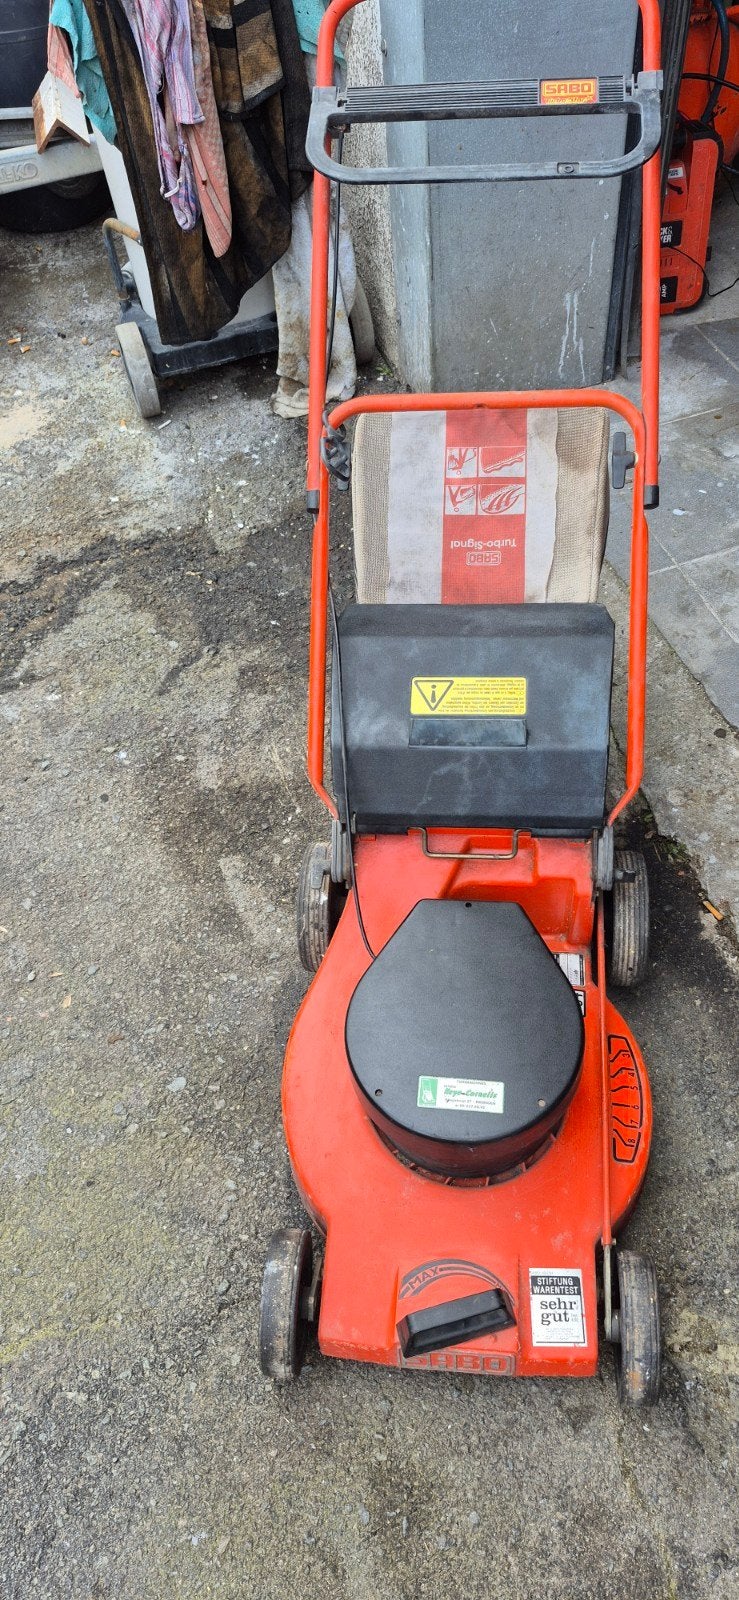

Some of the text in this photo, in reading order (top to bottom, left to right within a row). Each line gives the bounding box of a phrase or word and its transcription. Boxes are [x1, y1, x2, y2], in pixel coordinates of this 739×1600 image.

[545, 83, 592, 94] SABO
[450, 538, 517, 549] Turbo-Signal
[468, 553, 500, 563] SABO
[408, 1266, 439, 1289] MAX
[537, 1277, 574, 1285] STIFTUNG
[533, 1286, 578, 1294] WARENTEST
[540, 1298, 576, 1310] sehr
[541, 1310, 570, 1326] gut
